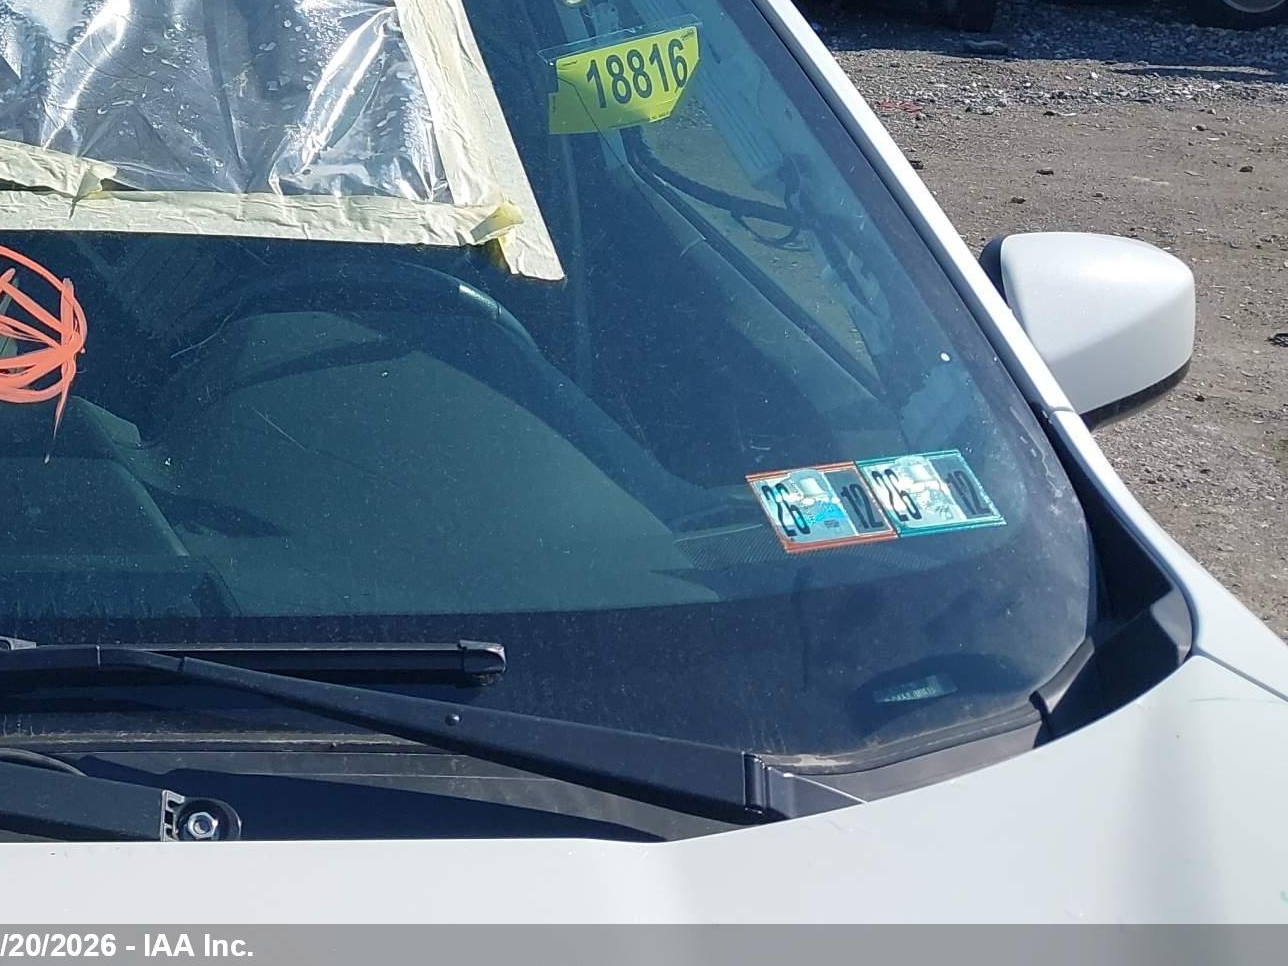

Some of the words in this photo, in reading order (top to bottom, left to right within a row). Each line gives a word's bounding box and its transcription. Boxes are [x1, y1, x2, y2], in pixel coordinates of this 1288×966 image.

[585, 38, 688, 109] 18816
[761, 482, 811, 537] 26
[840, 483, 884, 530] 12
[871, 468, 923, 522] 26
[945, 470, 992, 516] 12
